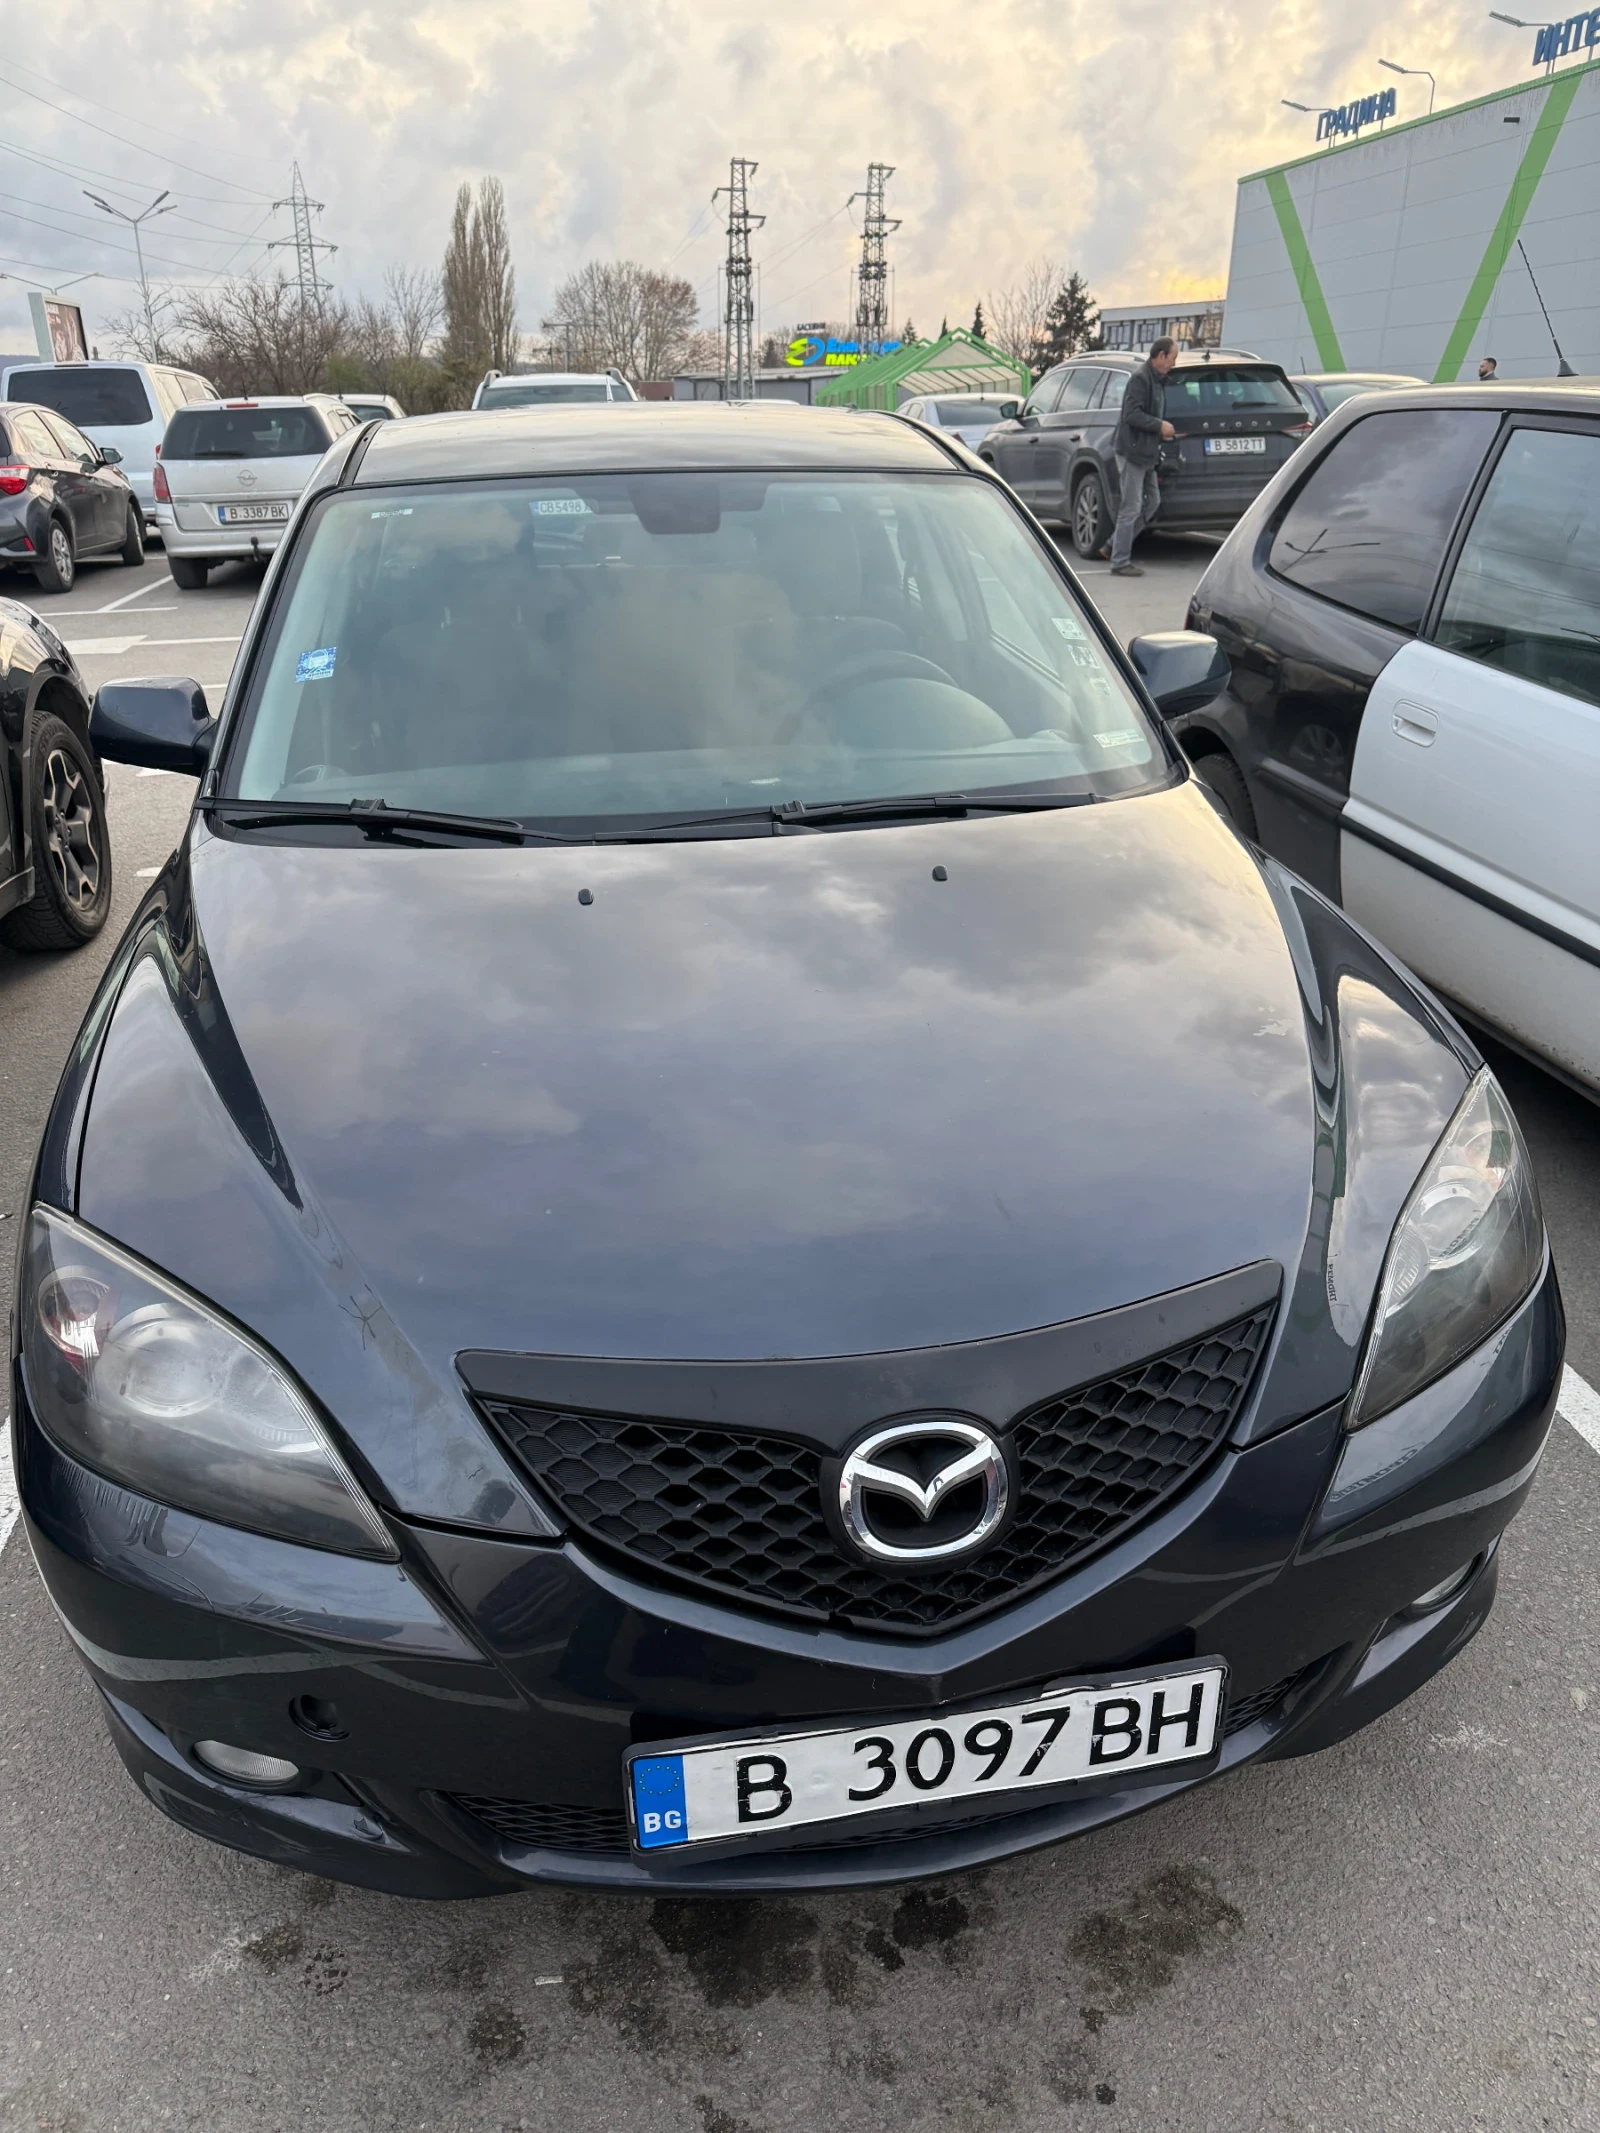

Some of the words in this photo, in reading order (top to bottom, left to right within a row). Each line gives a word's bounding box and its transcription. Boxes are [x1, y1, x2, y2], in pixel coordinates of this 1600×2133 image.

[1532, 6, 1600, 66] ИНТЕ
[1316, 87, 1396, 142] ГРАДИНА
[737, 1754, 793, 1823] B
[848, 1706, 1071, 1802] 3097
[1089, 1683, 1204, 1766] BH
[643, 1810, 682, 1834] BG
